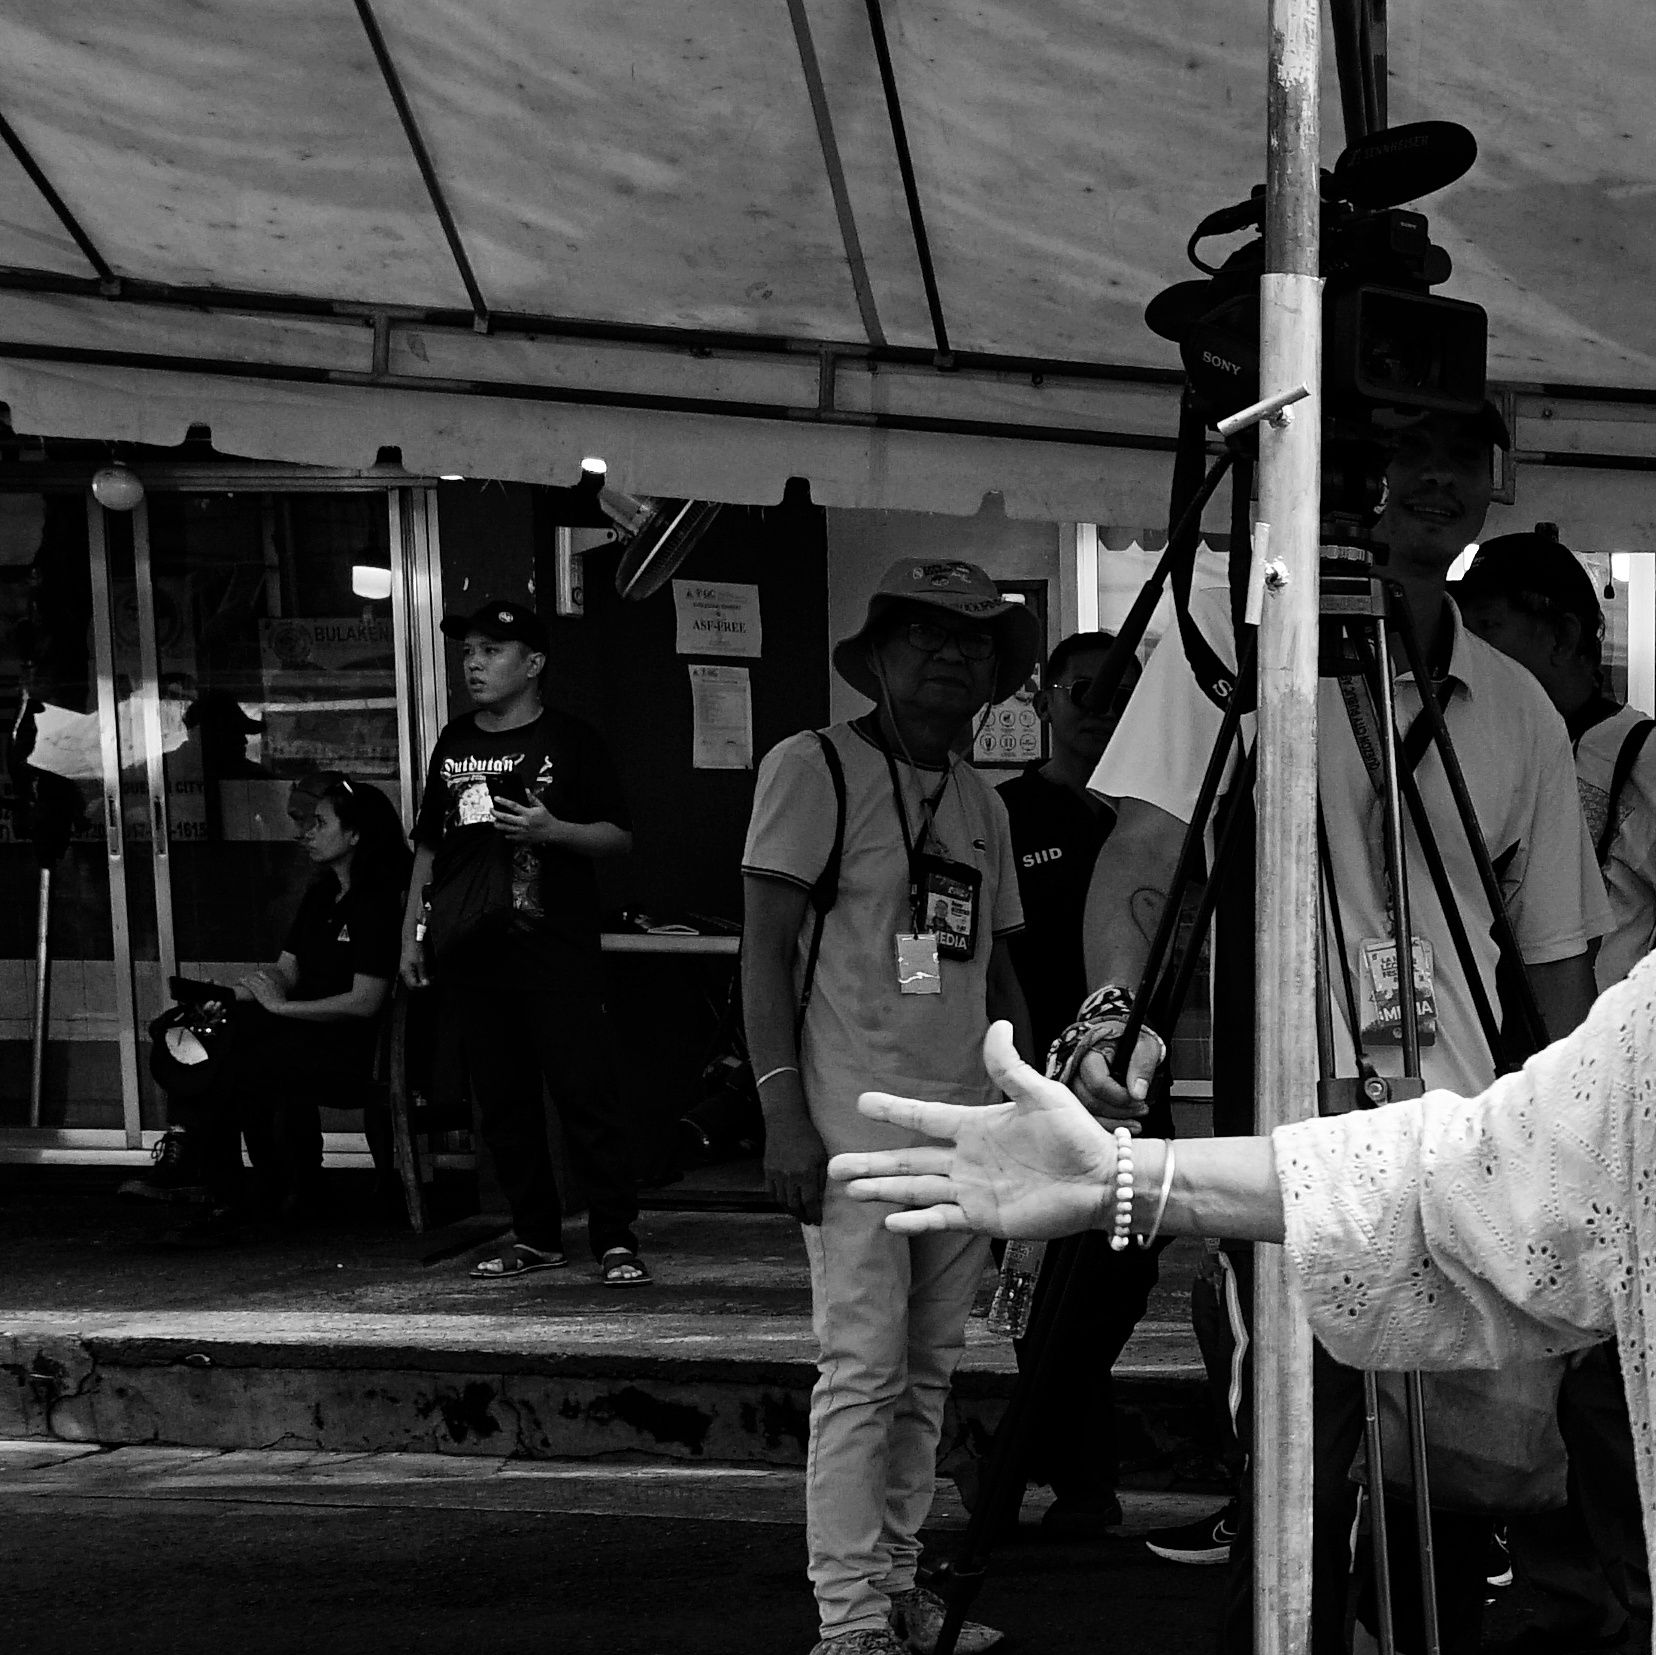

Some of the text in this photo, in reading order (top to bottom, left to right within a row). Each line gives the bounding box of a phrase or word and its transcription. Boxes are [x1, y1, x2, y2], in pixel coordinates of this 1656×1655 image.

[1201, 351, 1242, 375] SONY
[314, 626, 389, 642] BULAKEN
[693, 620, 746, 634] ASF-FREE
[1022, 847, 1063, 868] SIID
[1383, 1000, 1433, 1021] MIA
